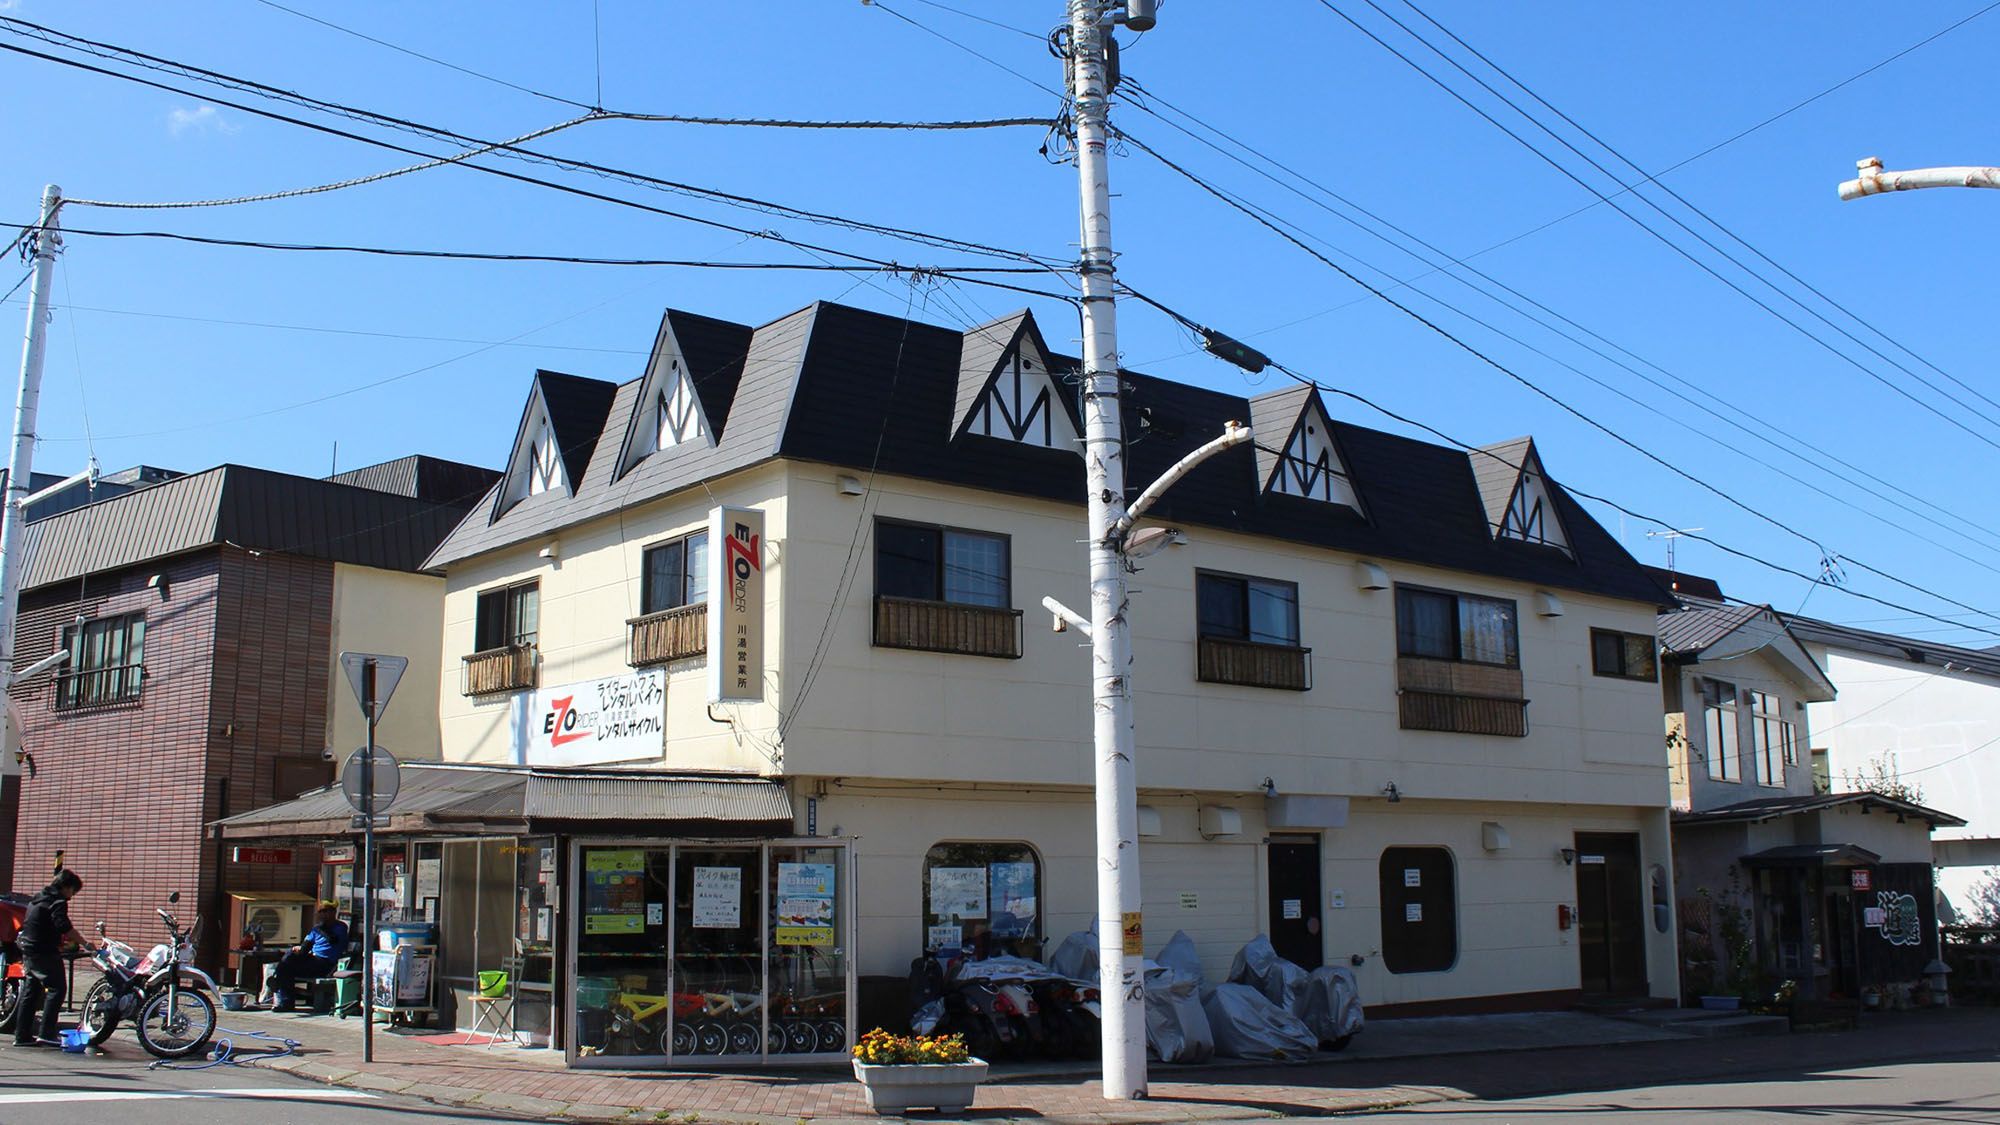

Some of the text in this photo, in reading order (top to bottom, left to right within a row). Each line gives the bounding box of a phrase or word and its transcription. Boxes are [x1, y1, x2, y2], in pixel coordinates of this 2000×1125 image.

[736, 624, 747, 688] 川湯営業所
[603, 689, 662, 711] レンタルバイク
[598, 716, 661, 741] レンタルサイクル
